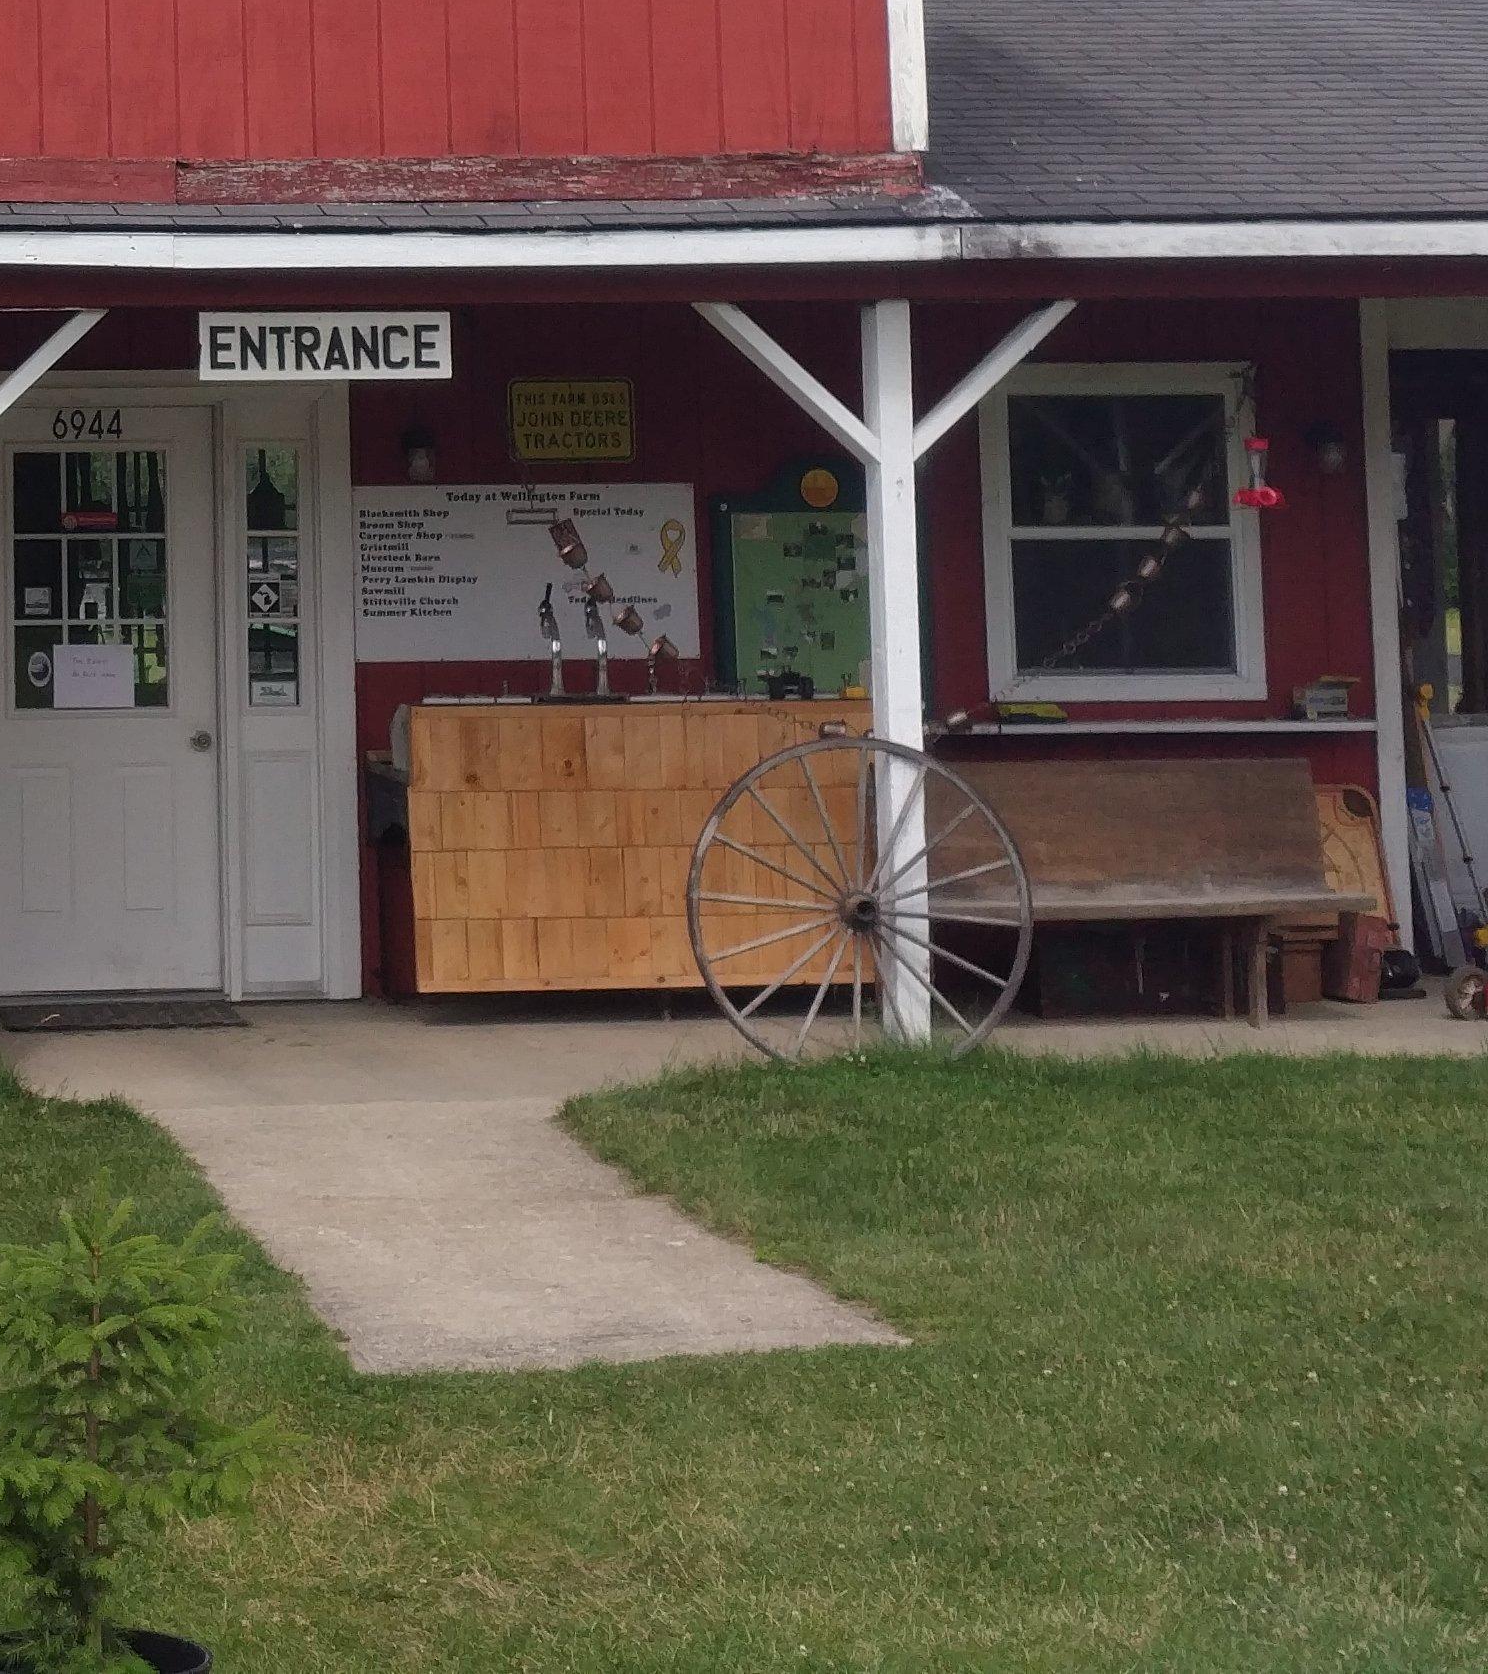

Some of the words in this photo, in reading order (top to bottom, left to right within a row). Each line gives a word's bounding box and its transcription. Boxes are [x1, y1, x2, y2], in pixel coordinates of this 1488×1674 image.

[209, 324, 441, 371] ENTRANCE
[516, 411, 564, 427] JOHN
[570, 410, 629, 427] DEERE
[52, 408, 123, 440] 6944
[523, 431, 622, 449] TRACTORS
[445, 492, 482, 503] Today
[485, 492, 497, 501] at
[500, 491, 567, 503] Wellington
[569, 491, 601, 501] Farm
[358, 509, 420, 519] Blacksmith
[423, 508, 450, 519] Shop
[573, 507, 612, 517] Special
[614, 507, 645, 517] Today
[359, 521, 394, 530] Broom
[397, 520, 424, 531] Shop
[358, 532, 413, 541] Carpenter
[416, 532, 443, 542] Shop
[360, 543, 410, 552] Gristmill
[361, 554, 412, 562] Livestock
[415, 554, 441, 562] Barn
[361, 565, 405, 573] Museum
[362, 576, 392, 585] Perry
[438, 575, 479, 585] Display
[361, 587, 406, 595] Sawmill
[419, 596, 459, 606] Church
[363, 608, 407, 618] Summer
[409, 608, 453, 617] Kitchen
